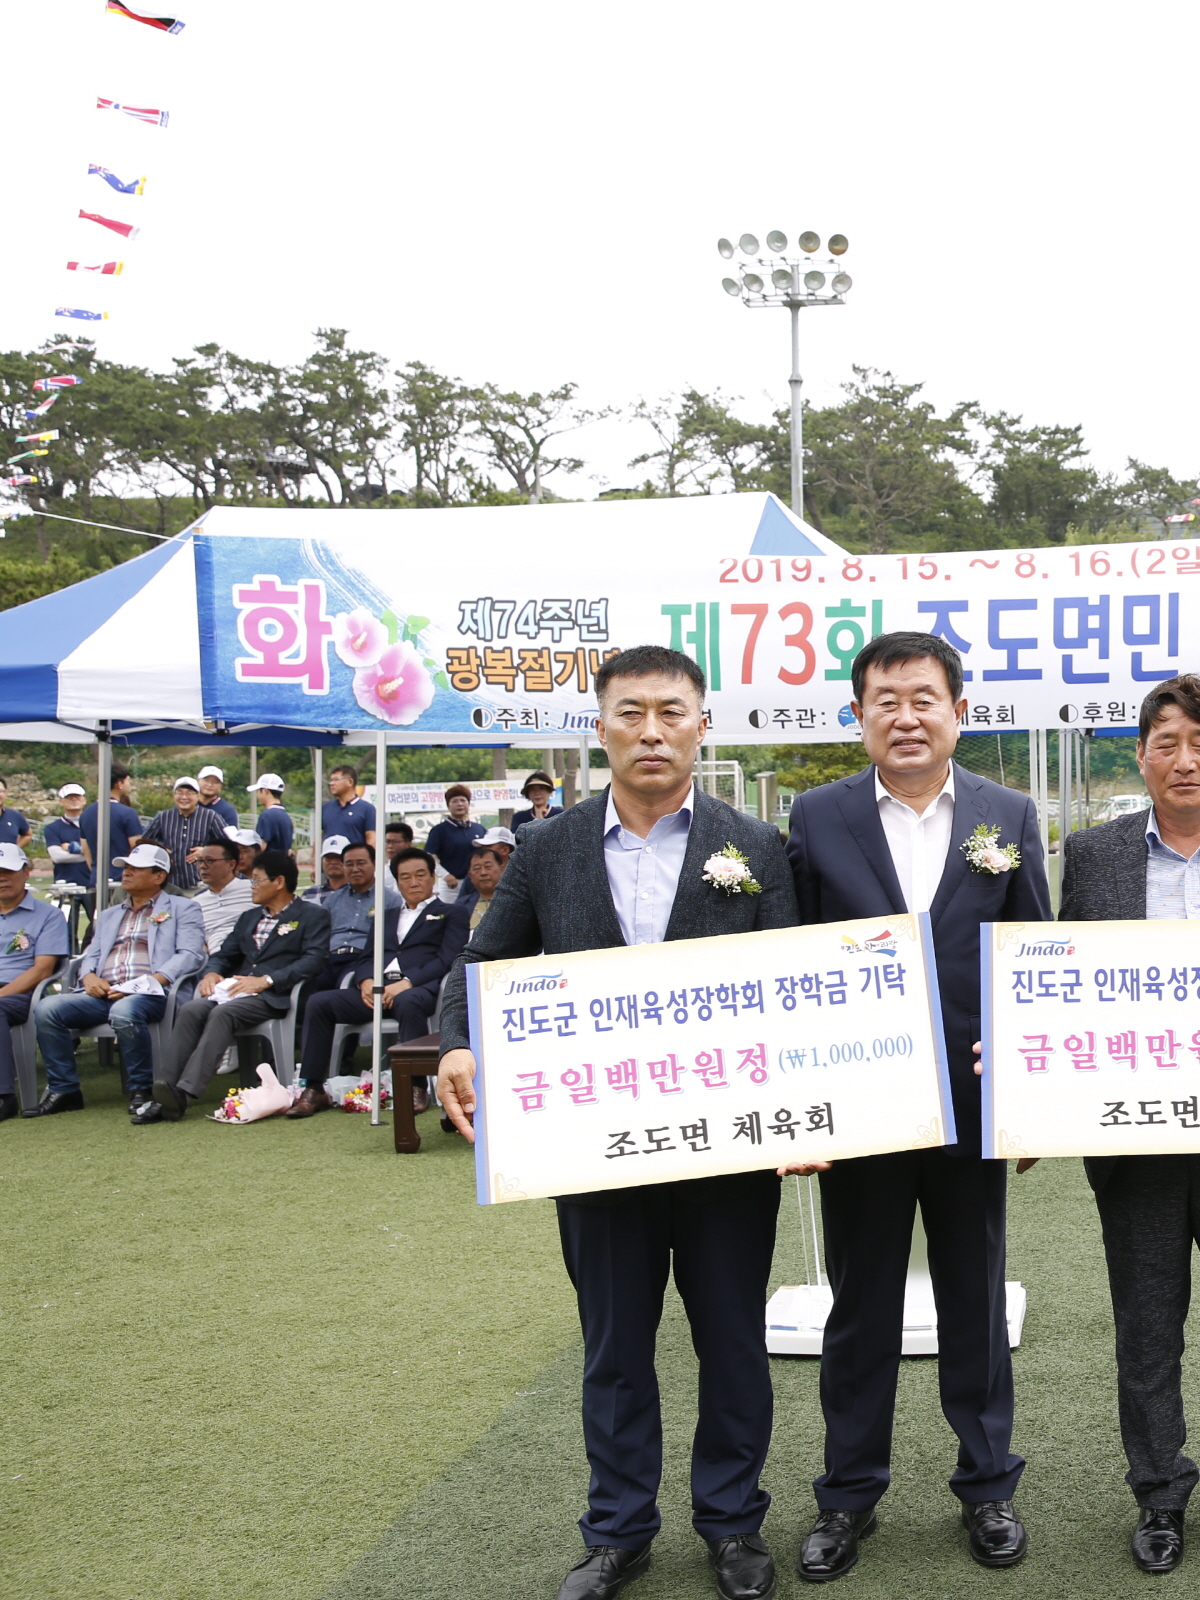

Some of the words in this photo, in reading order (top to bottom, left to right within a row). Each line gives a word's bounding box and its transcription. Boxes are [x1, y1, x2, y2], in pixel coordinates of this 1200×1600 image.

[719, 557, 825, 583] 2019.
[842, 557, 876, 582] 8.
[896, 556, 951, 580] 15.
[1014, 553, 1049, 578] 8.
[235, 577, 334, 692] 화
[458, 597, 609, 642] 제74주년
[918, 592, 1179, 684] 조도면민
[496, 707, 549, 729] 주최:
[772, 708, 826, 729] 주관:
[1082, 701, 1136, 723] 후원:
[1015, 944, 1065, 957] Jindo
[502, 1002, 577, 1042] 진도군
[590, 980, 764, 1032] 인재육성장학회
[775, 970, 847, 1011] 장학금
[859, 963, 906, 999] 기탁
[505, 979, 557, 995] Jindo
[1012, 969, 1083, 1003] 진도군
[511, 1042, 770, 1112] 금일백만원정
[1099, 1096, 1200, 1128] 조도면
[605, 1118, 711, 1159] 조도면
[733, 1102, 834, 1145] 체육회
